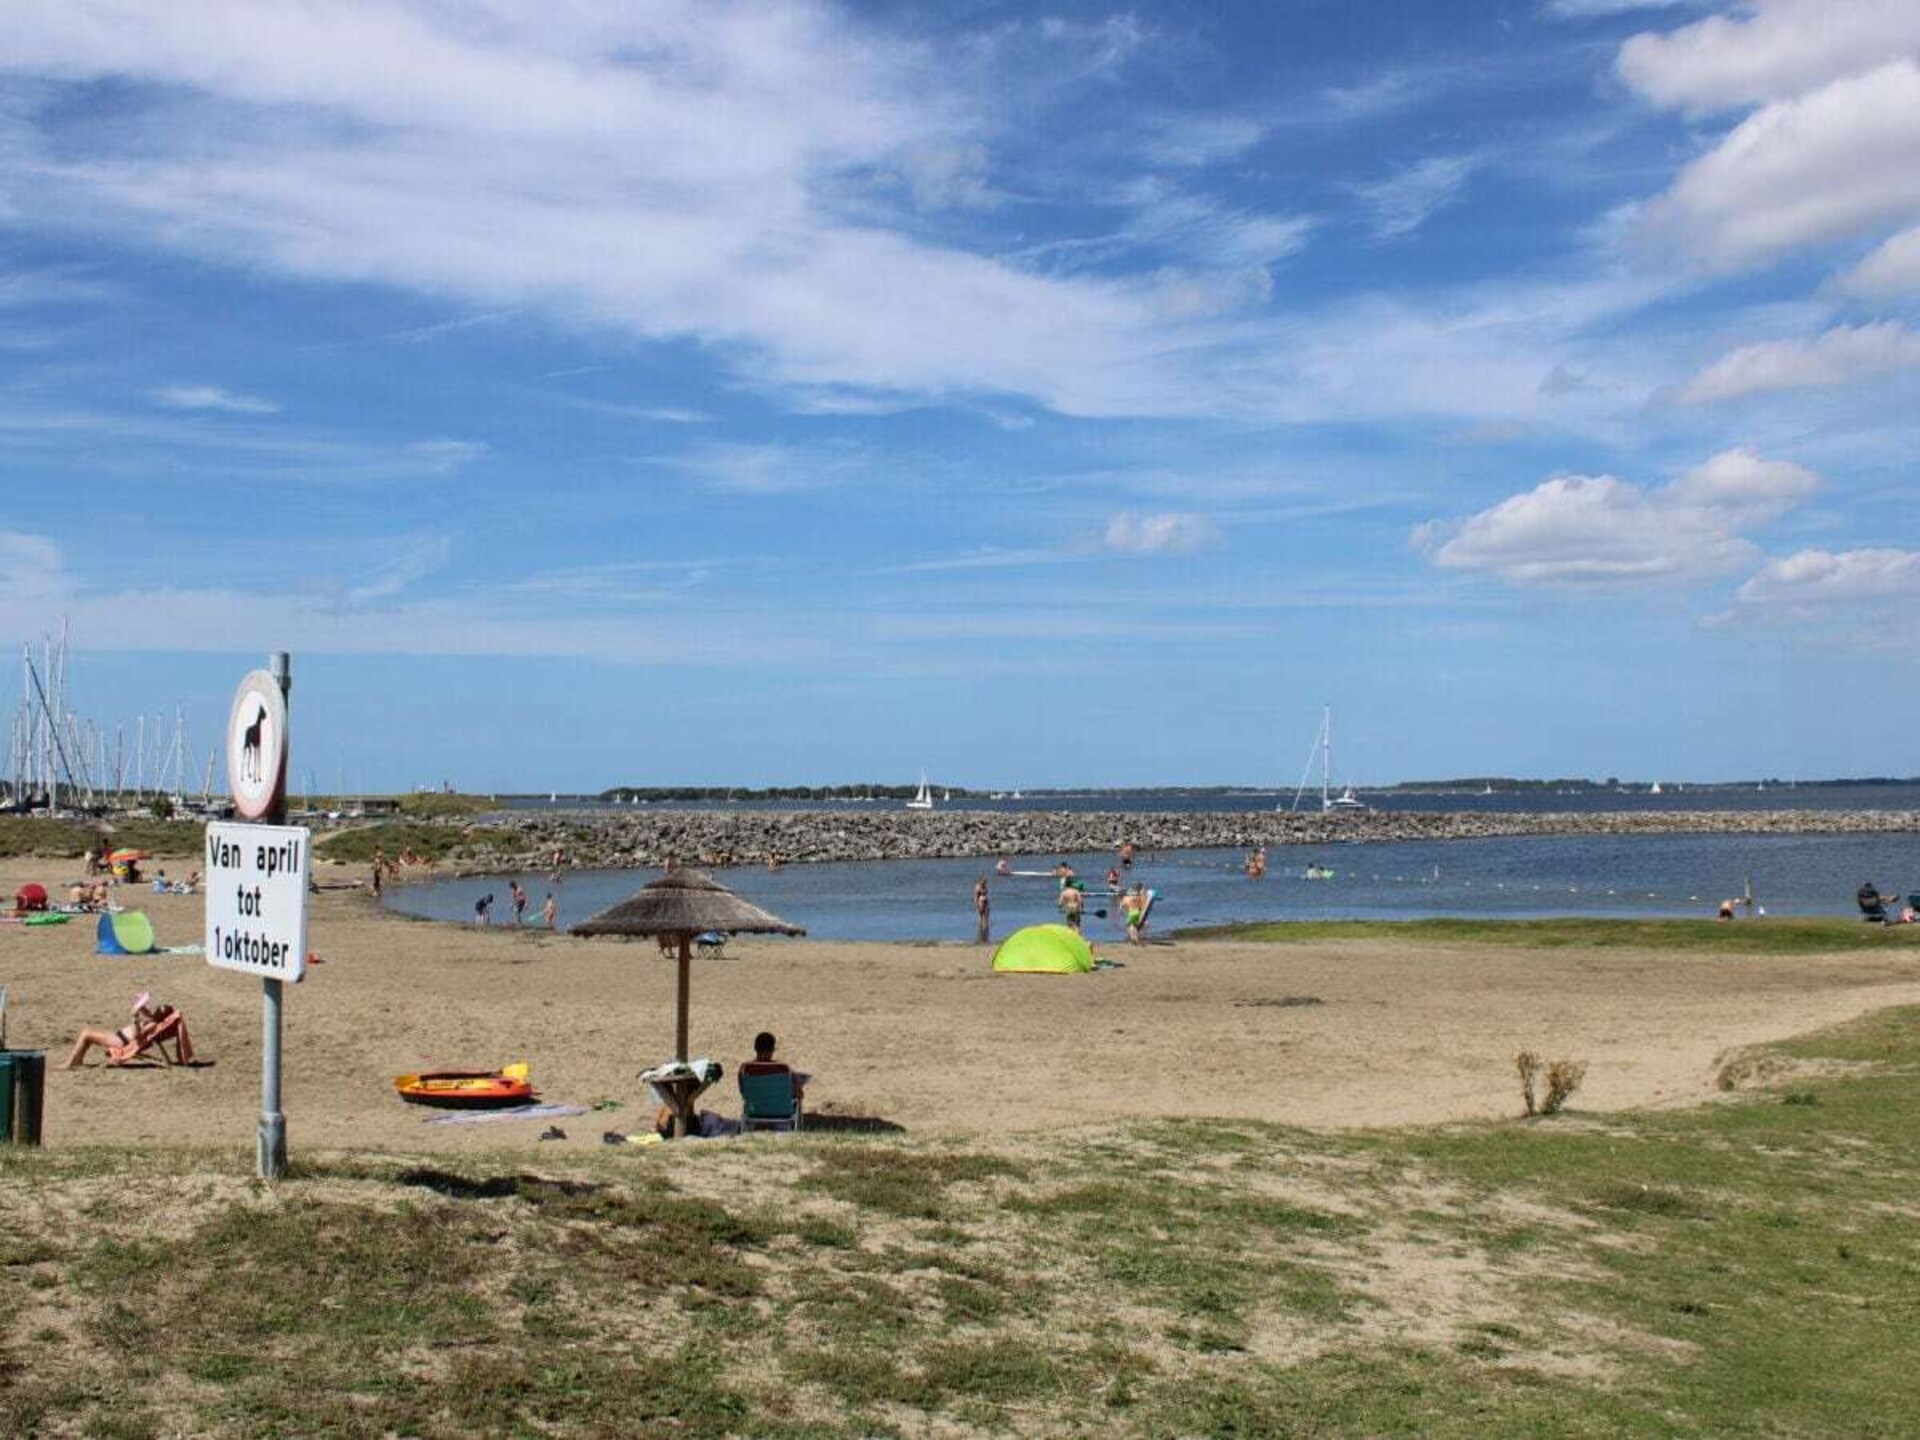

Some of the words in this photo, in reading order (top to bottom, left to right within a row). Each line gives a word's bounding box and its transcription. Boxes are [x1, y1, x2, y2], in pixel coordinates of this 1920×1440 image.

[209, 835, 241, 869] Van
[257, 840, 299, 878] april
[237, 884, 262, 917] tot
